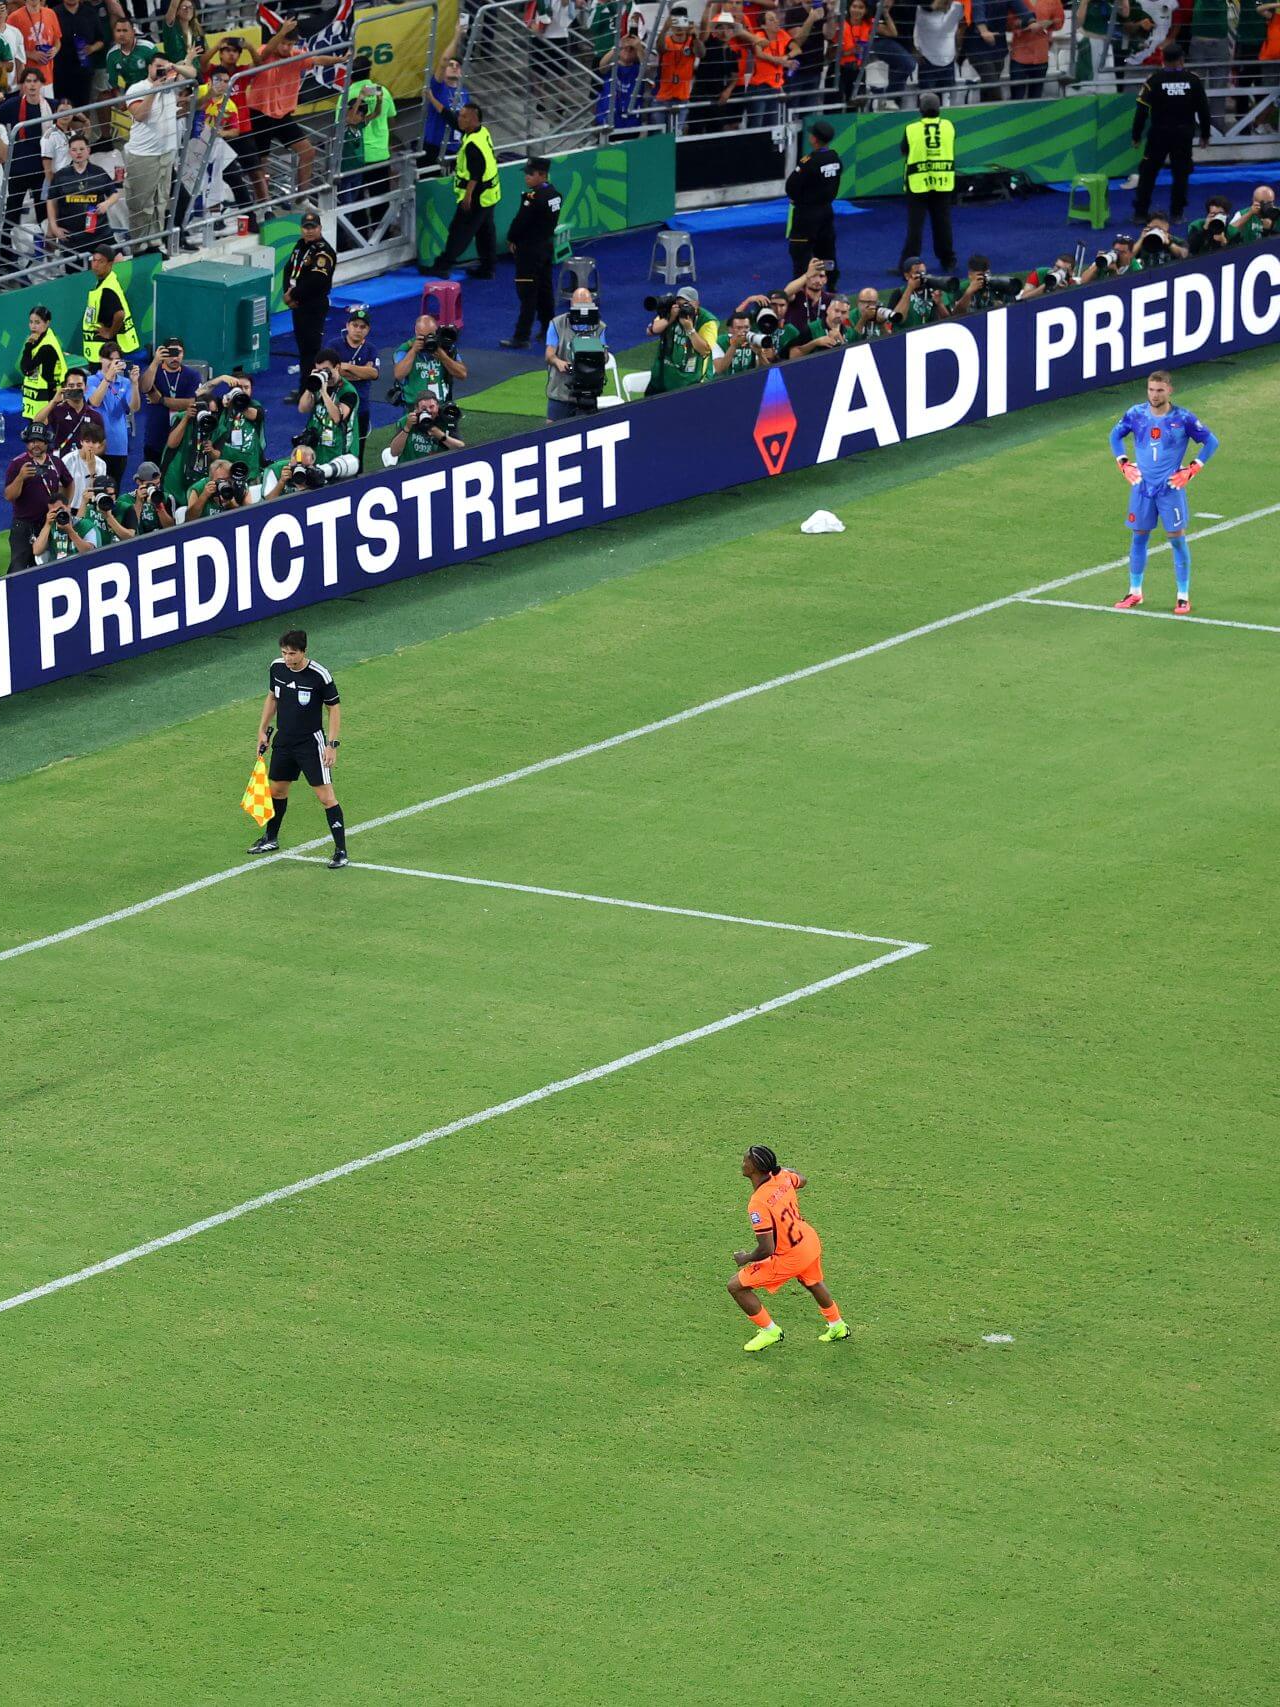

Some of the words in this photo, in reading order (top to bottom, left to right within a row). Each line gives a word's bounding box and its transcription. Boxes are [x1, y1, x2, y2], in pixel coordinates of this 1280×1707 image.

[817, 308, 1007, 464] ADI
[1035, 254, 1280, 391] PREDIC
[1151, 447, 1158, 462] 1
[38, 421, 630, 670] PREDICTSTREET
[1173, 507, 1181, 521] 1
